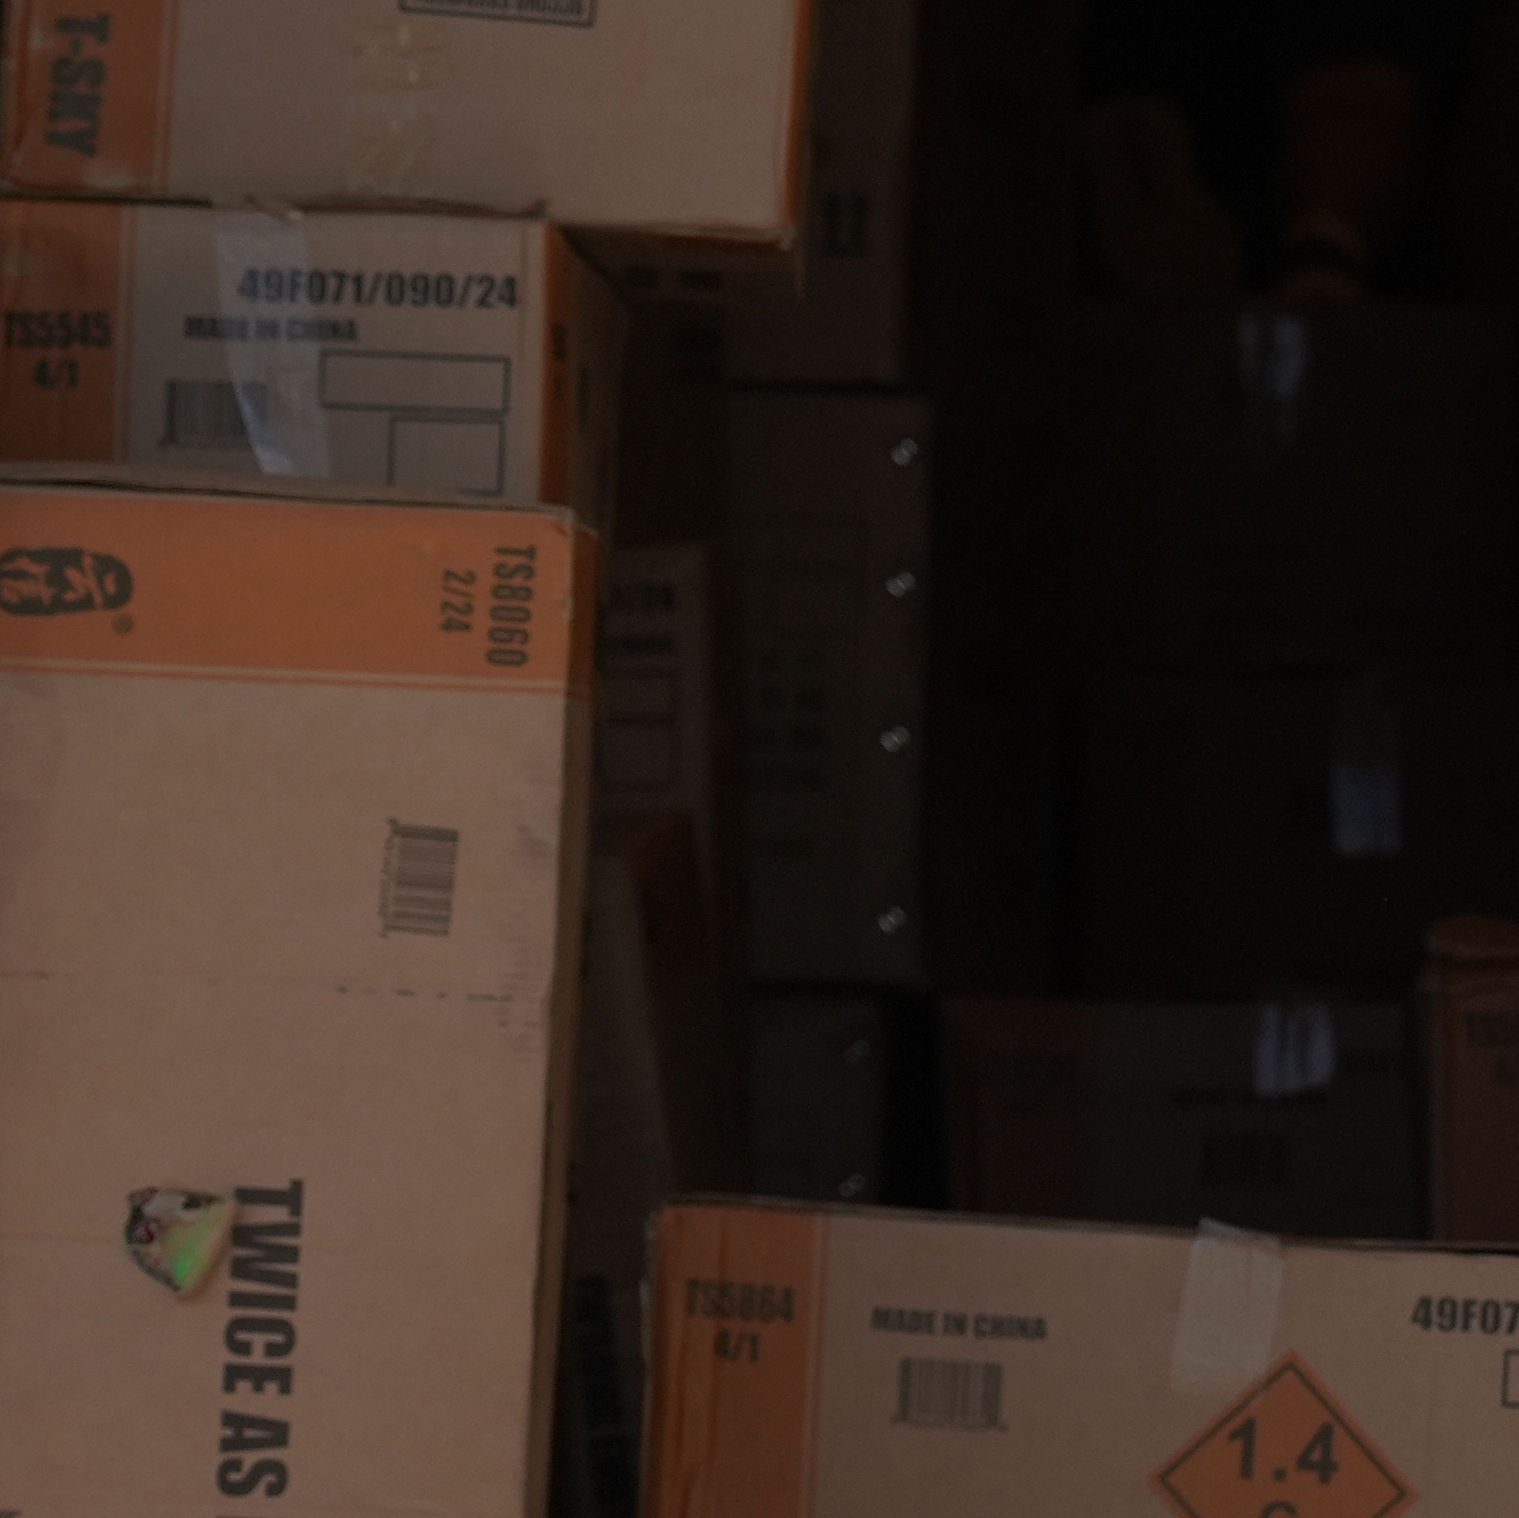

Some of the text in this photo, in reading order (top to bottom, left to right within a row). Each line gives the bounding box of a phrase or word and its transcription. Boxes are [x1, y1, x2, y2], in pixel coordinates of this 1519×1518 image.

[45, 12, 112, 156] T-SKY
[237, 267, 520, 310] 49F071/090/24
[3, 309, 112, 350] TS5545
[184, 316, 250, 340] MADE
[254, 319, 281, 341] IN
[31, 360, 80, 391] 4/1
[439, 568, 476, 633] 2/24
[486, 544, 537, 668] TS8060
[222, 1179, 305, 1398] TWICE
[871, 1306, 1048, 1342] MADE IN CHINA
[215, 1410, 291, 1498] AS
[1226, 1417, 1340, 1487] 1.4
